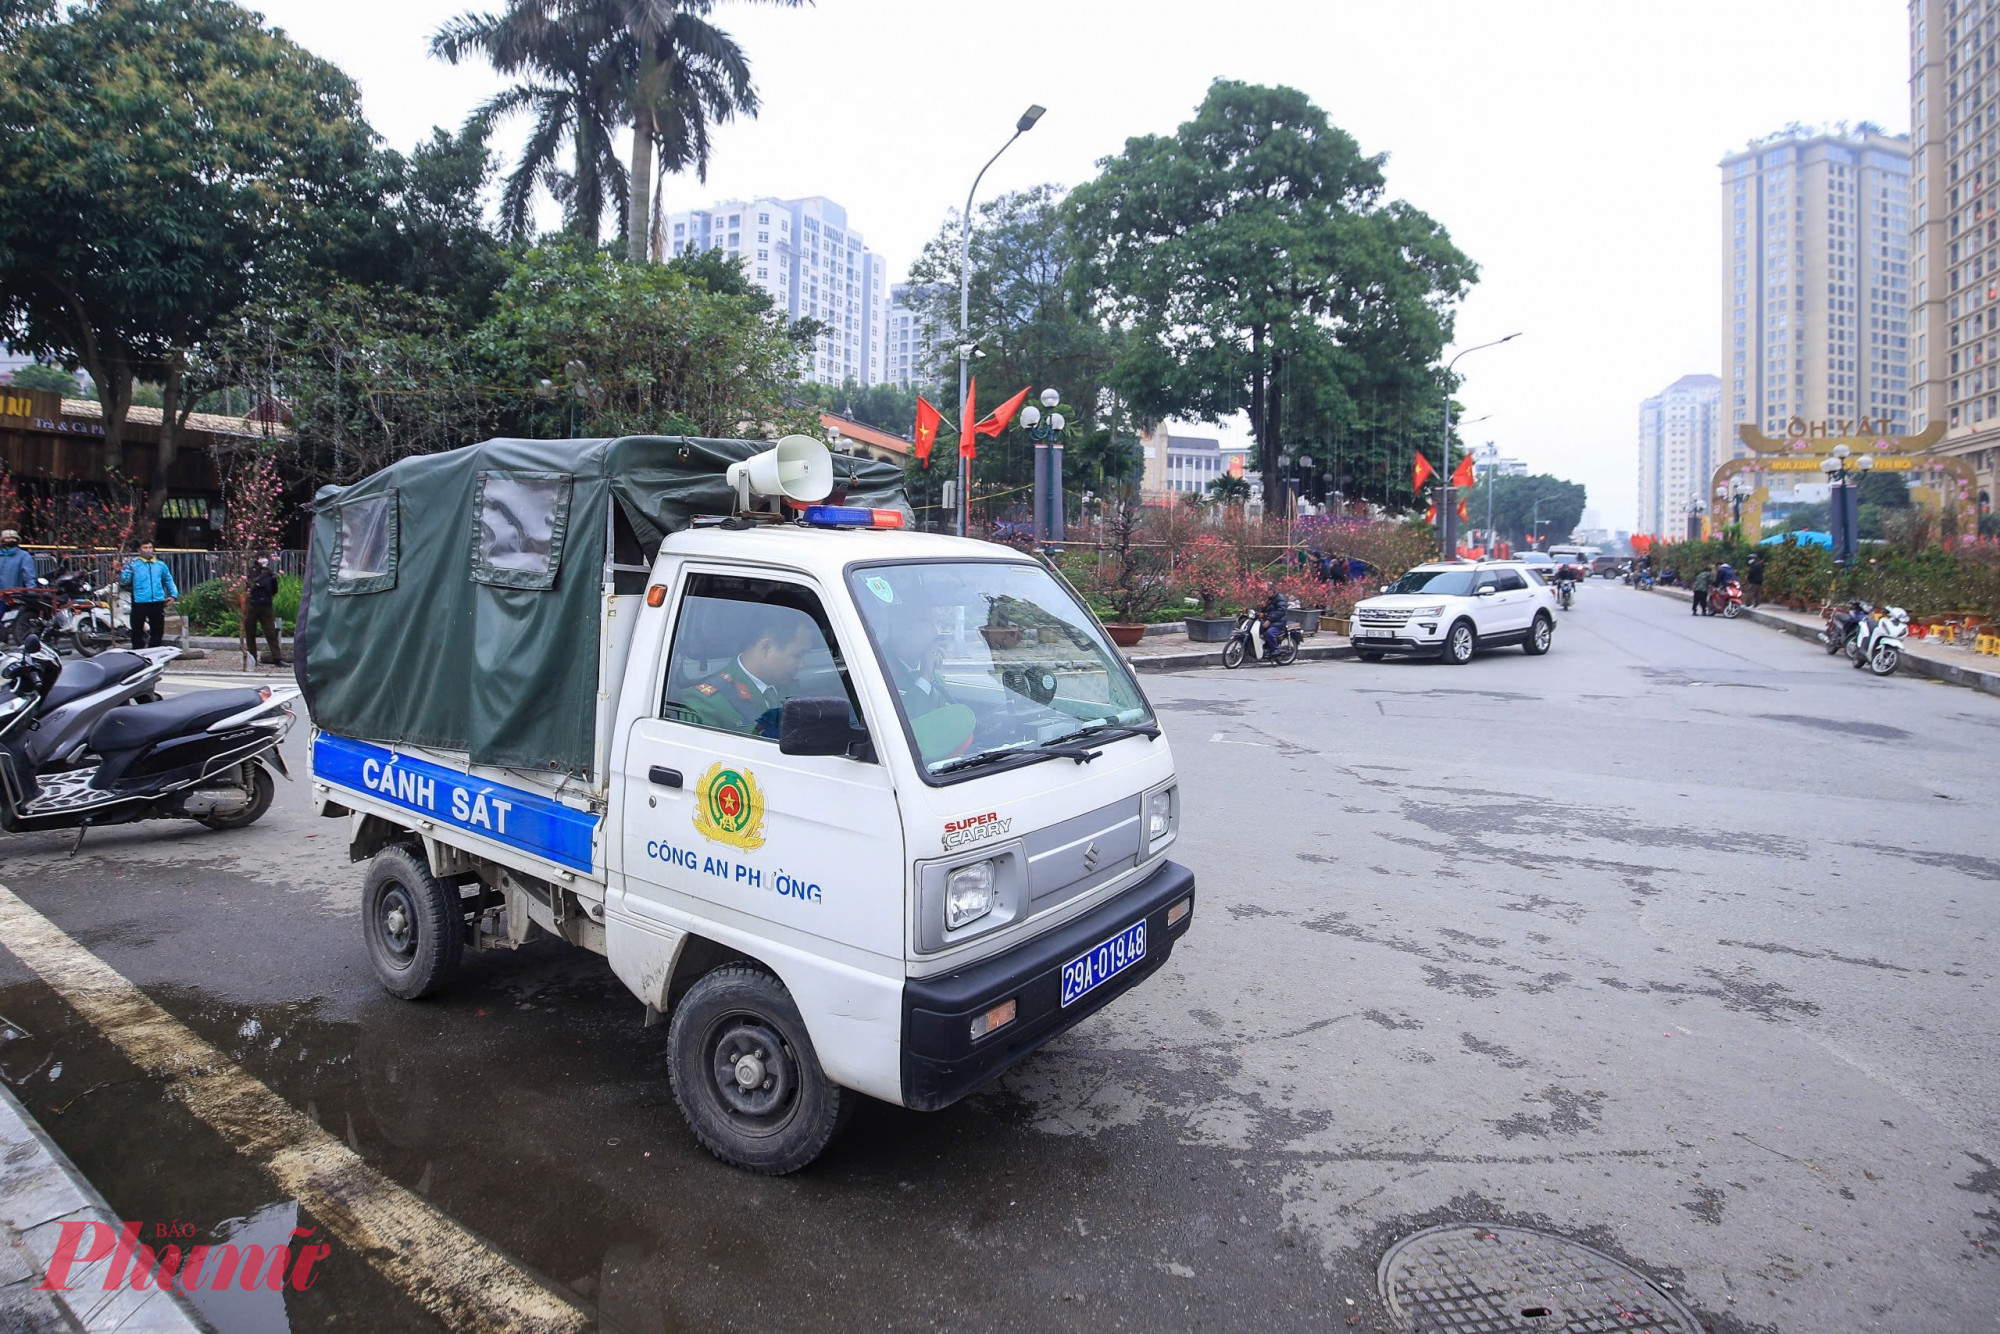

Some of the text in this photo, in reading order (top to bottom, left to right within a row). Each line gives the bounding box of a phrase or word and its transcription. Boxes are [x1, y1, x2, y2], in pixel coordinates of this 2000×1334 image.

[35, 418, 55, 430] Trà
[57, 421, 68, 431] &
[91, 425, 106, 435] Ph
[452, 787, 512, 834] SÁT
[944, 812, 998, 843] SUPER
[945, 817, 1012, 847] CARRY
[647, 840, 697, 871] CÔNG
[703, 856, 728, 879] AN
[1064, 925, 1144, 1002] 29A-019.48
